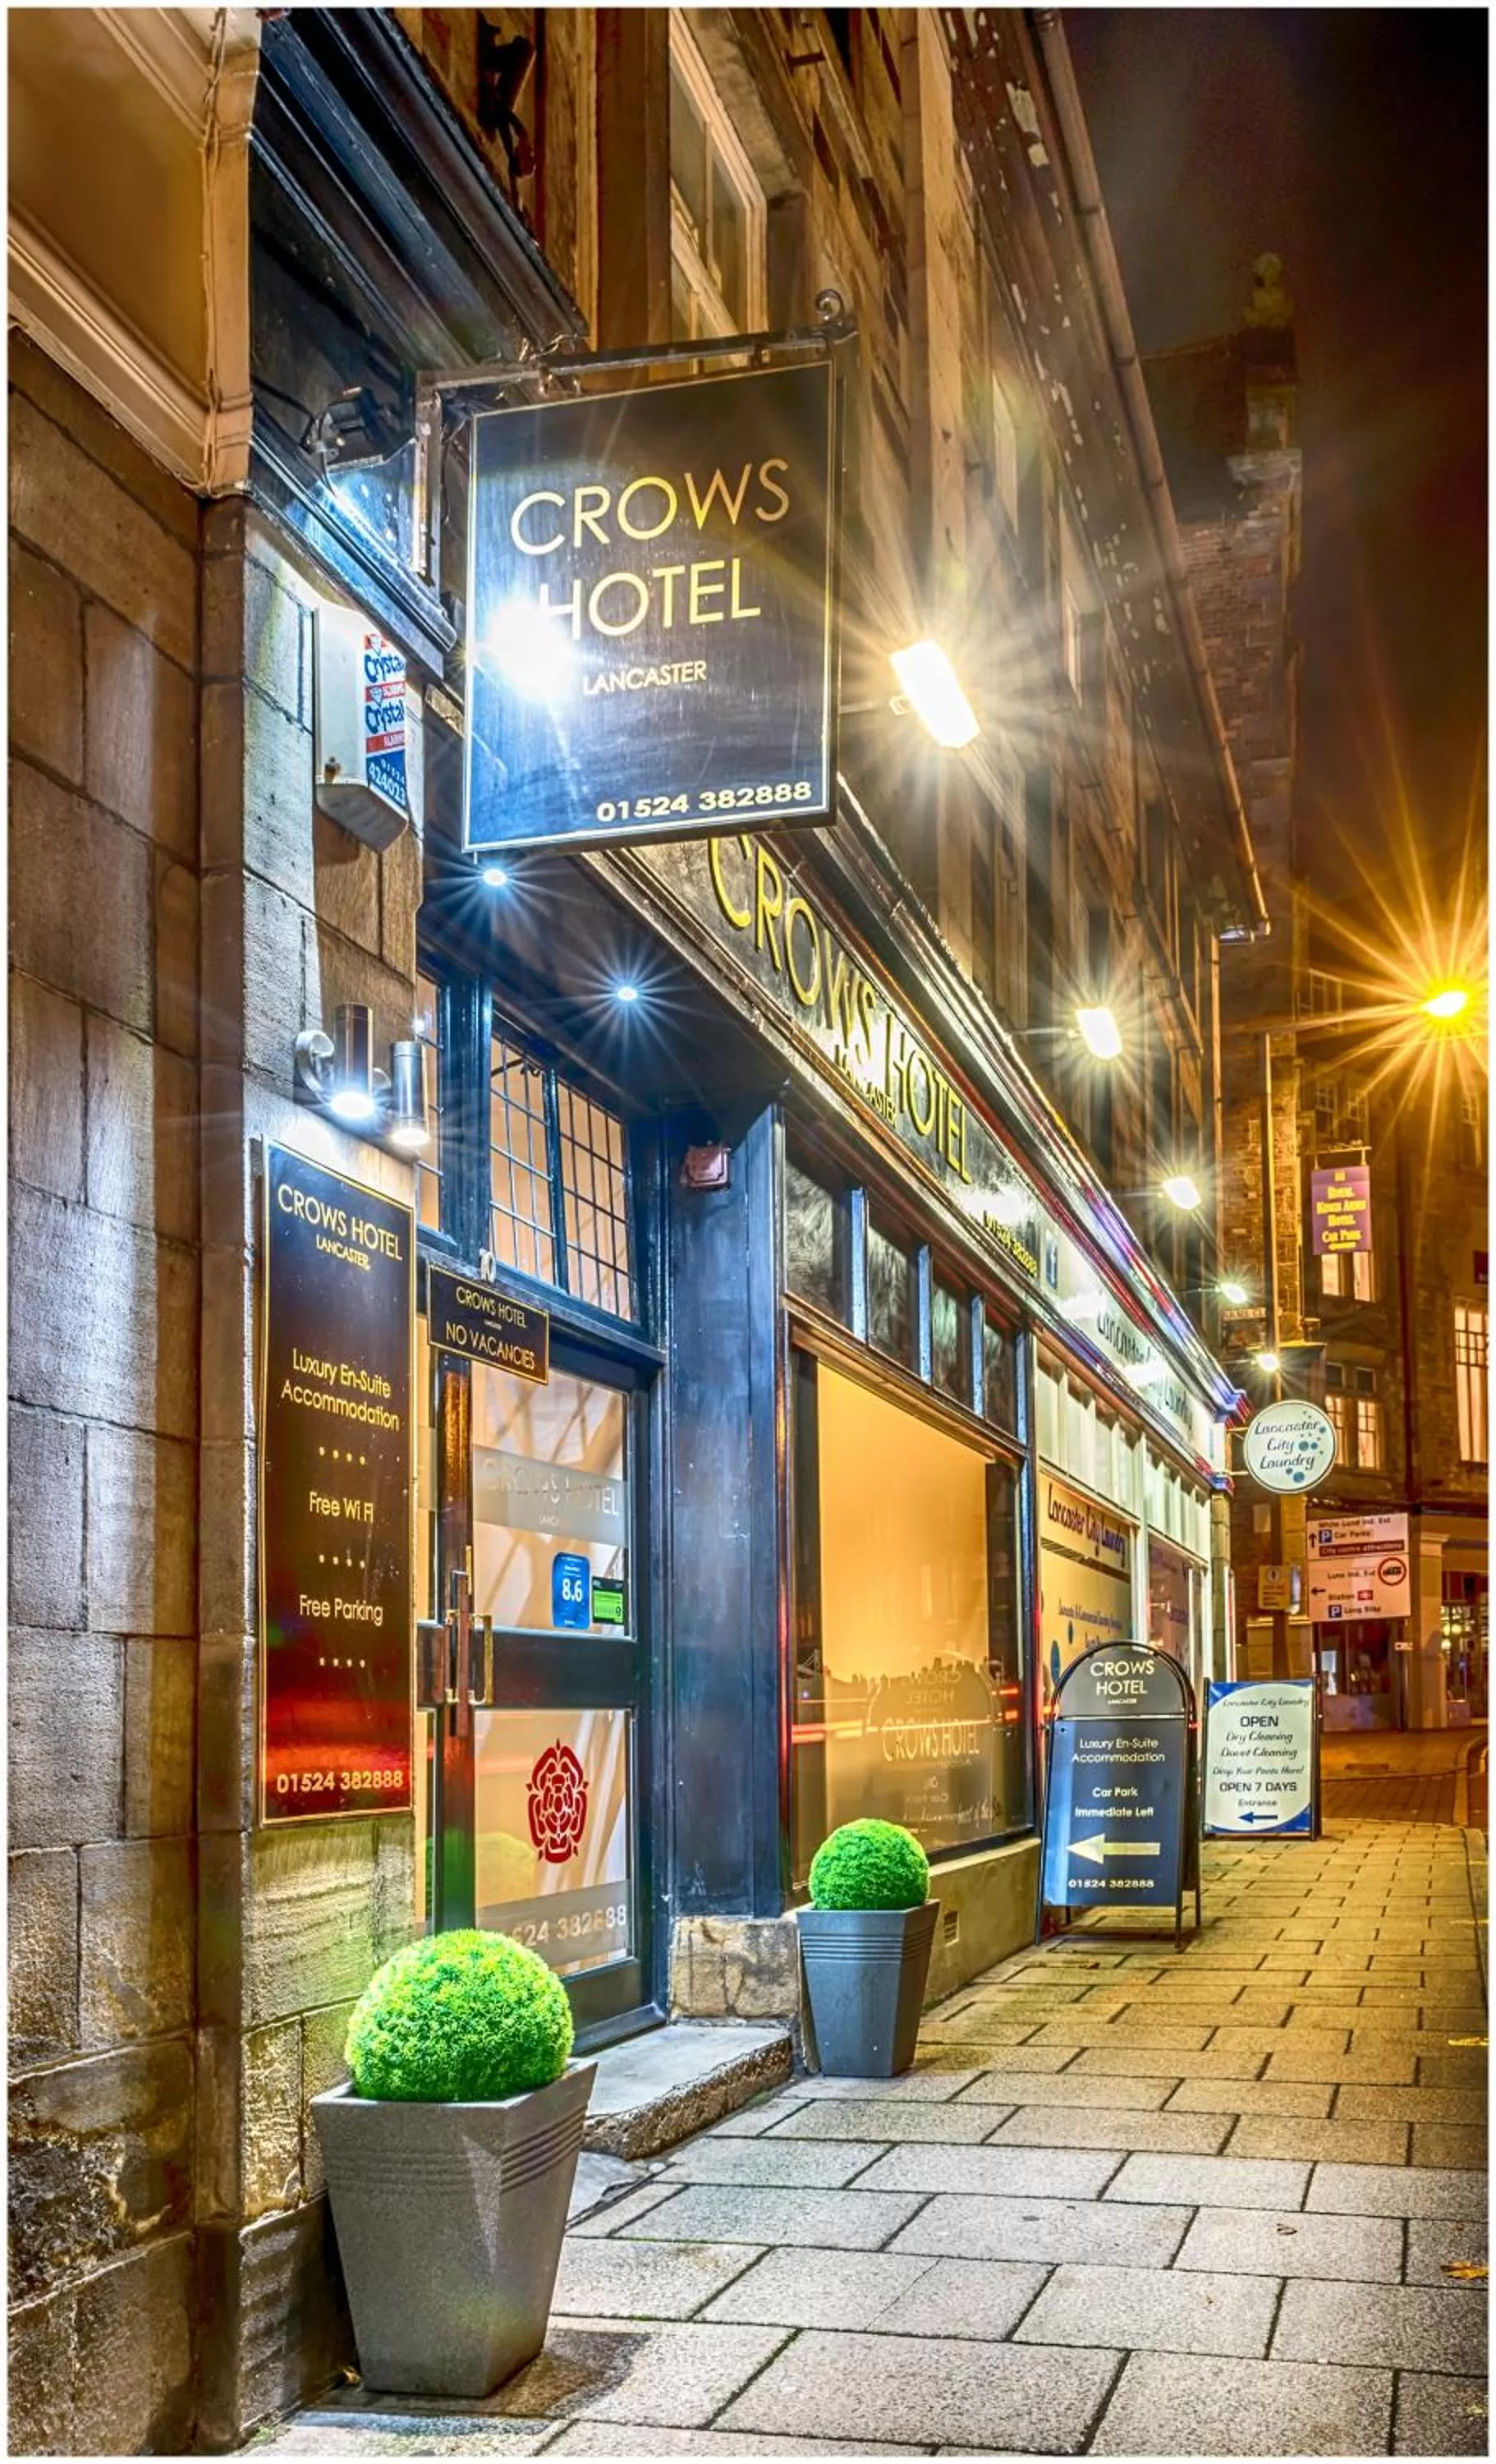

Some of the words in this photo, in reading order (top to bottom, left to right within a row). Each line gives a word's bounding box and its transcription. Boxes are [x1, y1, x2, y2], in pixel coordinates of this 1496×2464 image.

[511, 458, 789, 555] CROWS
[539, 558, 760, 640] HOTEL
[582, 660, 707, 695] LANCASTER
[597, 795, 688, 822] 01524
[699, 781, 811, 811] 382888
[708, 834, 877, 1062] CROWS
[884, 1013, 972, 1184] HOTEL
[278, 1184, 346, 1236] CROWS
[351, 1216, 403, 1262] HOTEL
[316, 1234, 369, 1269] LANCASTER
[457, 1286, 496, 1316] CROWS
[498, 1303, 527, 1328] HOTEL
[446, 1320, 466, 1345] NO
[469, 1329, 535, 1370] VACANCIES
[293, 1348, 337, 1386] Luxury
[341, 1363, 391, 1398] En-Suite
[281, 1380, 399, 1431] Accommodation
[1254, 1422, 1320, 1434] Lancaster
[1267, 1437, 1294, 1455] City
[1260, 1454, 1315, 1470] Laundry
[310, 1491, 341, 1517] Free
[1048, 1483, 1085, 1534] Lancaster
[562, 1578, 583, 1602] 8.6
[300, 1594, 330, 1617] Free
[334, 1597, 383, 1626] Parking
[1090, 1660, 1154, 1677] CROWS
[1096, 1680, 1148, 1696] HOTEL
[1240, 1716, 1279, 1727] OPEN
[1080, 1738, 1113, 1750] Luxury
[1116, 1737, 1159, 1749] En-Suite
[1226, 1731, 1246, 1745] Dry
[1249, 1731, 1293, 1743] Cleaning
[1072, 1751, 1165, 1763] Accommodation
[1253, 1747, 1298, 1760] Cleaning
[277, 1772, 334, 1793] 01524
[340, 1770, 403, 1791] 382888
[1092, 1787, 1112, 1798] Car
[1114, 1787, 1138, 1797] Park
[1219, 1781, 1251, 1792] OPEN
[1255, 1781, 1262, 1792] 7
[1266, 1781, 1297, 1791] DAYS
[1075, 1807, 1132, 1817] Immediate
[1136, 1807, 1154, 1817] Left
[1238, 1799, 1278, 1807] Entrance
[1068, 1878, 1106, 1888] 01524
[1109, 1878, 1155, 1888] 382888
[556, 1904, 627, 1940] 382888
